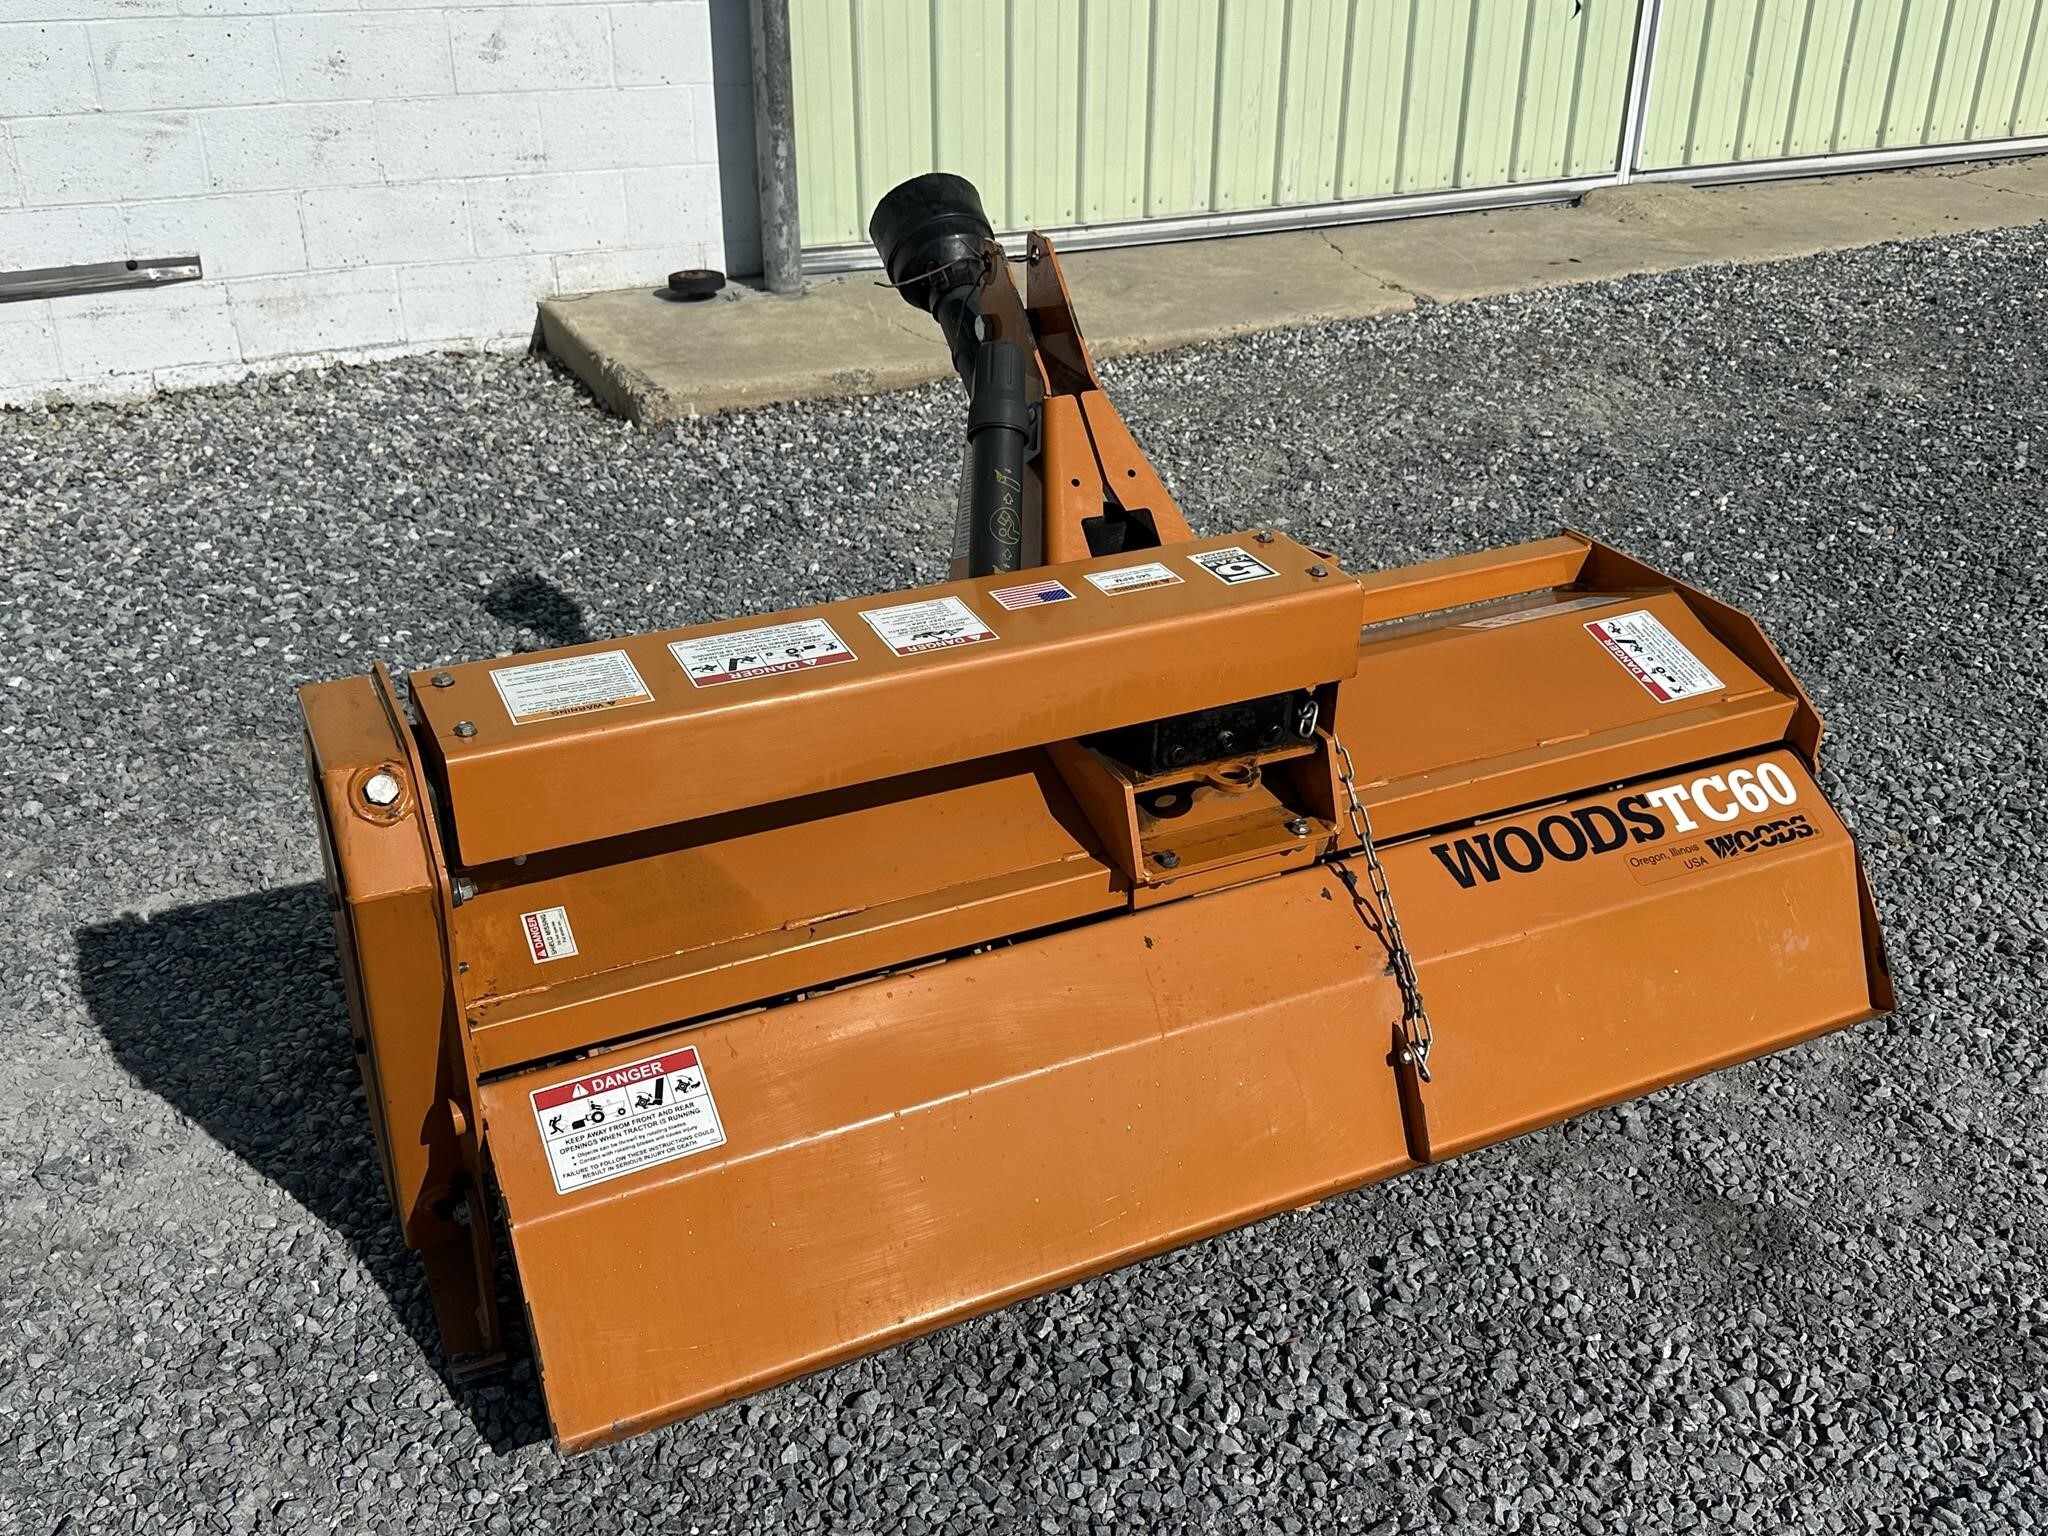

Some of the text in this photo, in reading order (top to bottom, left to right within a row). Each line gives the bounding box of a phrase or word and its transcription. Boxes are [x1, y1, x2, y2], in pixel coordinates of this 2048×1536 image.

[1210, 559, 1270, 581] 5
[905, 637, 966, 651] DANGER
[1602, 638, 1643, 674] DANGER
[727, 661, 799, 679] DANGER
[549, 703, 603, 715] WARNING
[1630, 843, 1700, 868] Oregon, Illinois
[1684, 857, 1709, 870] USA
[526, 916, 543, 948] DANGER
[591, 1061, 664, 1091] DANGER
[565, 1101, 694, 1145] KEEP AWAY FROM FRONT AND REAR
[559, 1138, 598, 1155] OPENINGS
[599, 1131, 621, 1142] WHEN
[623, 1120, 658, 1135] TRACTOR
[562, 1166, 589, 1178] FAILURE
[599, 1155, 626, 1167] FOLLOW
[627, 1148, 647, 1158] THESE
[648, 1134, 692, 1152] INSTRUCTIONS
[693, 1127, 714, 1138] COULD
[579, 1154, 600, 1164] Contact
[582, 1168, 606, 1179] RESULT
[615, 1156, 642, 1168] SERIOUS
[643, 1149, 665, 1160] INJURY
